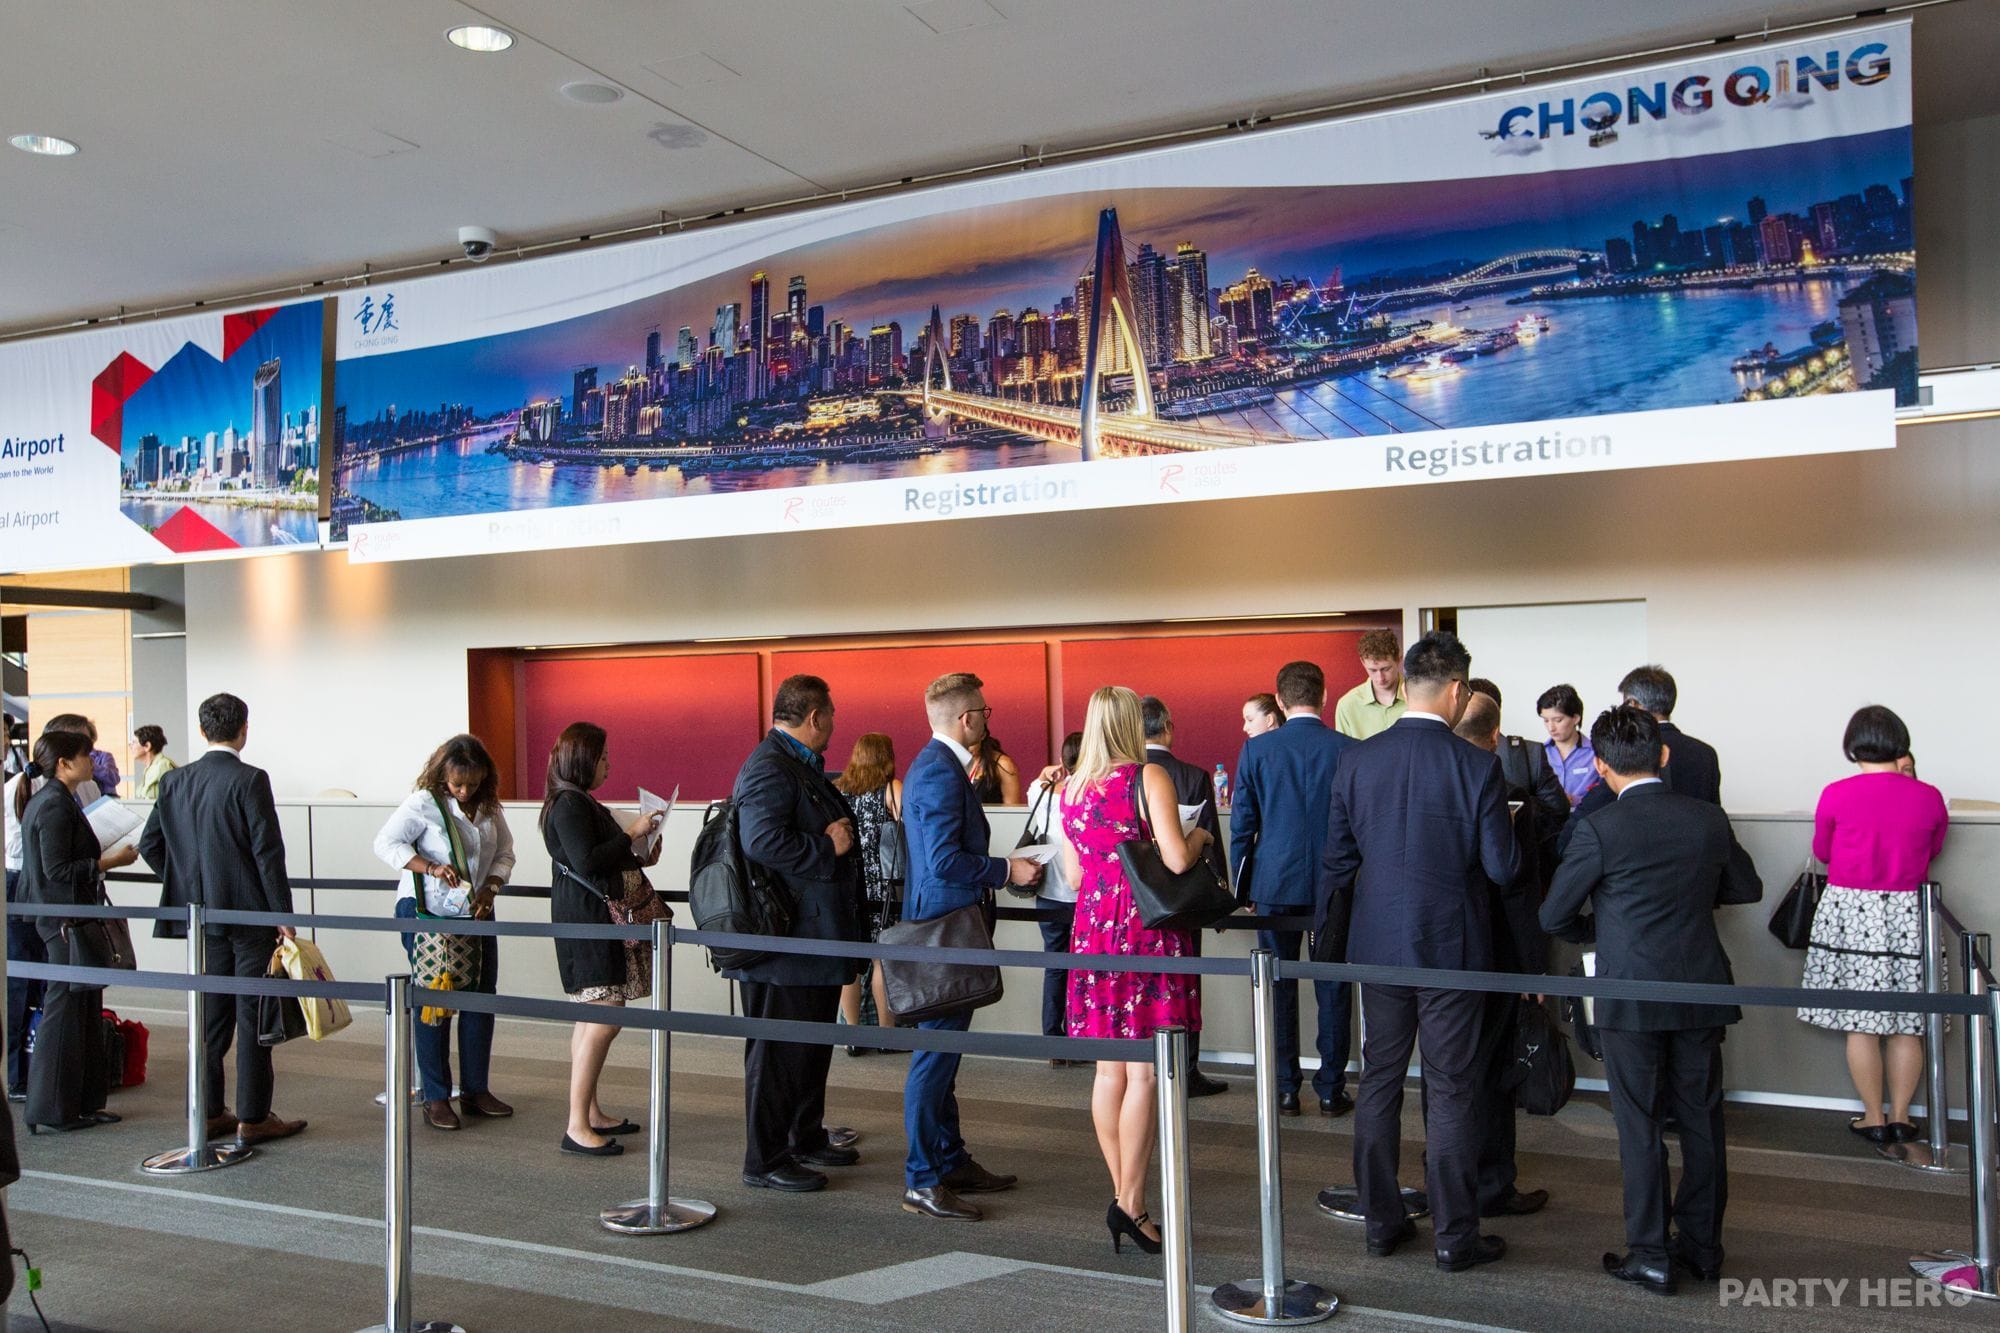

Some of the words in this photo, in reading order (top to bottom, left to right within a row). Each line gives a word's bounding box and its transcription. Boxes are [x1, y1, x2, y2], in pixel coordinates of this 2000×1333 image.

[2, 433, 64, 461] Airport
[1385, 431, 1612, 477] Registration
[13, 469, 20, 477] to
[22, 468, 32, 476] the
[34, 466, 54, 475] World
[905, 476, 1078, 515] Registration
[13, 510, 60, 530] Airport
